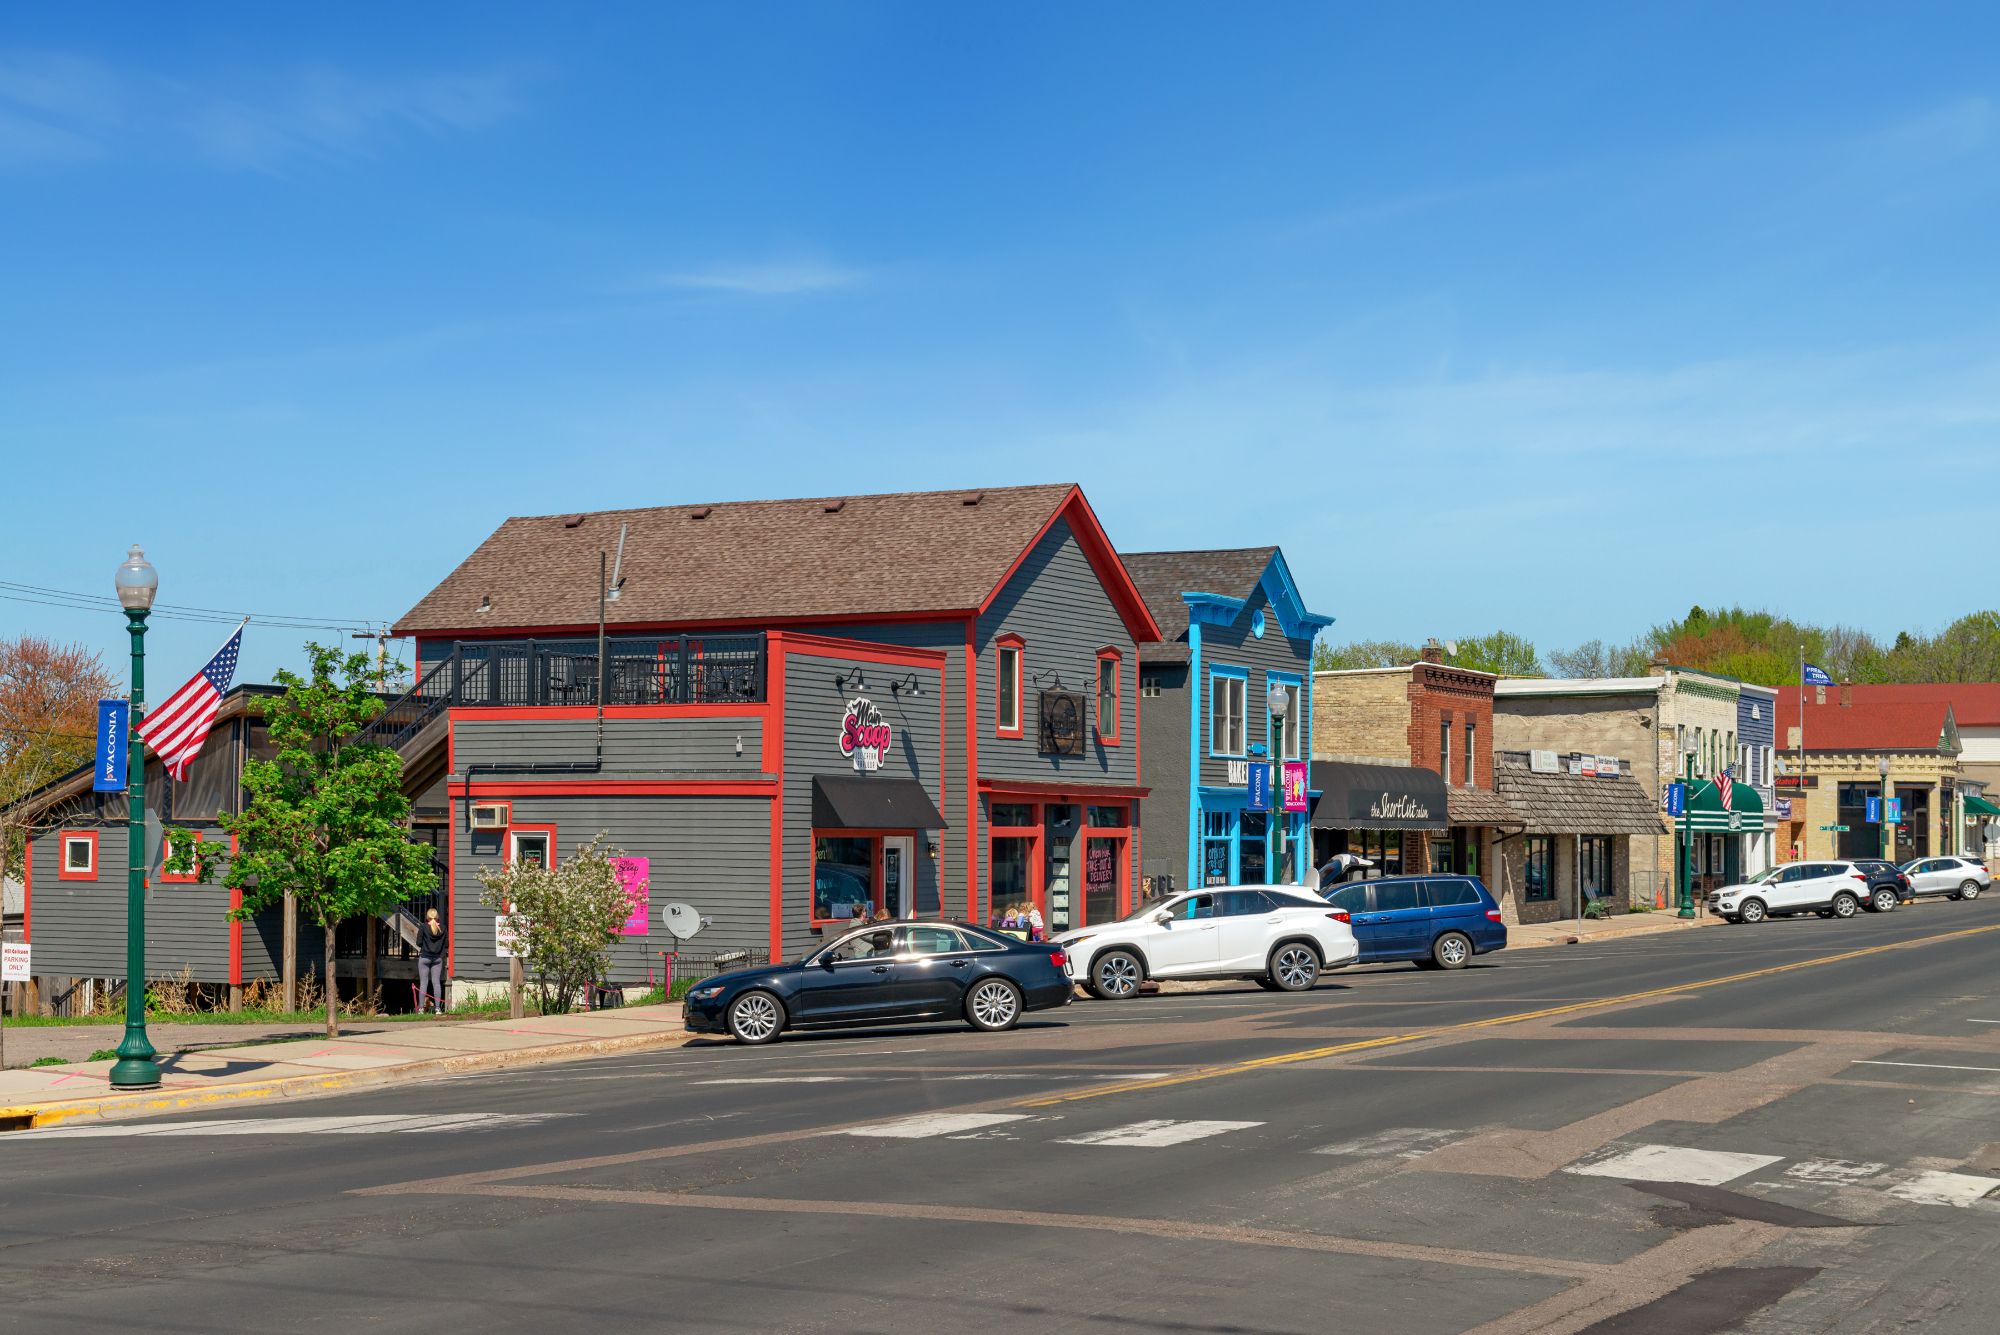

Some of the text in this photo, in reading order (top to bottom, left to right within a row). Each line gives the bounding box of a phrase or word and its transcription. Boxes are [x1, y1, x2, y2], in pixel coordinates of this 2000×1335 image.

[852, 700, 882, 726] Main
[105, 710, 117, 775] WACONIA
[842, 713, 891, 765] Scoop
[1254, 768, 1262, 804] WACONIA
[1370, 801, 1380, 817] the
[1090, 869, 1112, 882] DELIVERY
